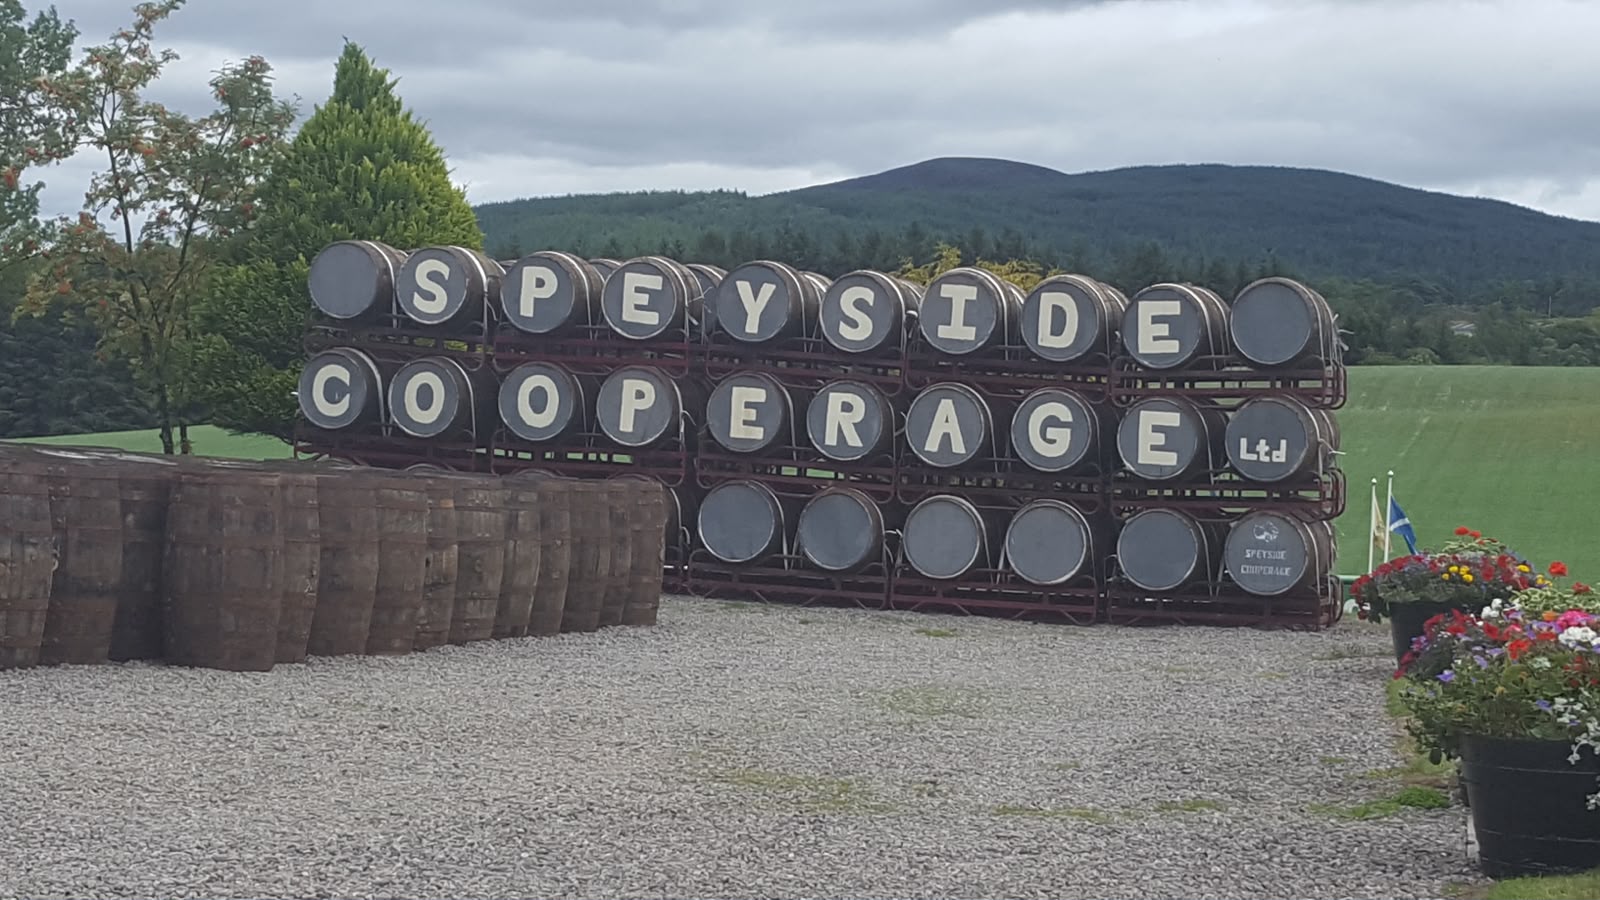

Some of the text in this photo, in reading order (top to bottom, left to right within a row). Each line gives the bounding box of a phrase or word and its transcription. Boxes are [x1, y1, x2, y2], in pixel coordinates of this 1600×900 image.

[413, 259, 1181, 354] SPEYSIDE
[311, 364, 1287, 466] COOPERAGE Ltd
[1245, 549, 1286, 560] SPEYSIDE
